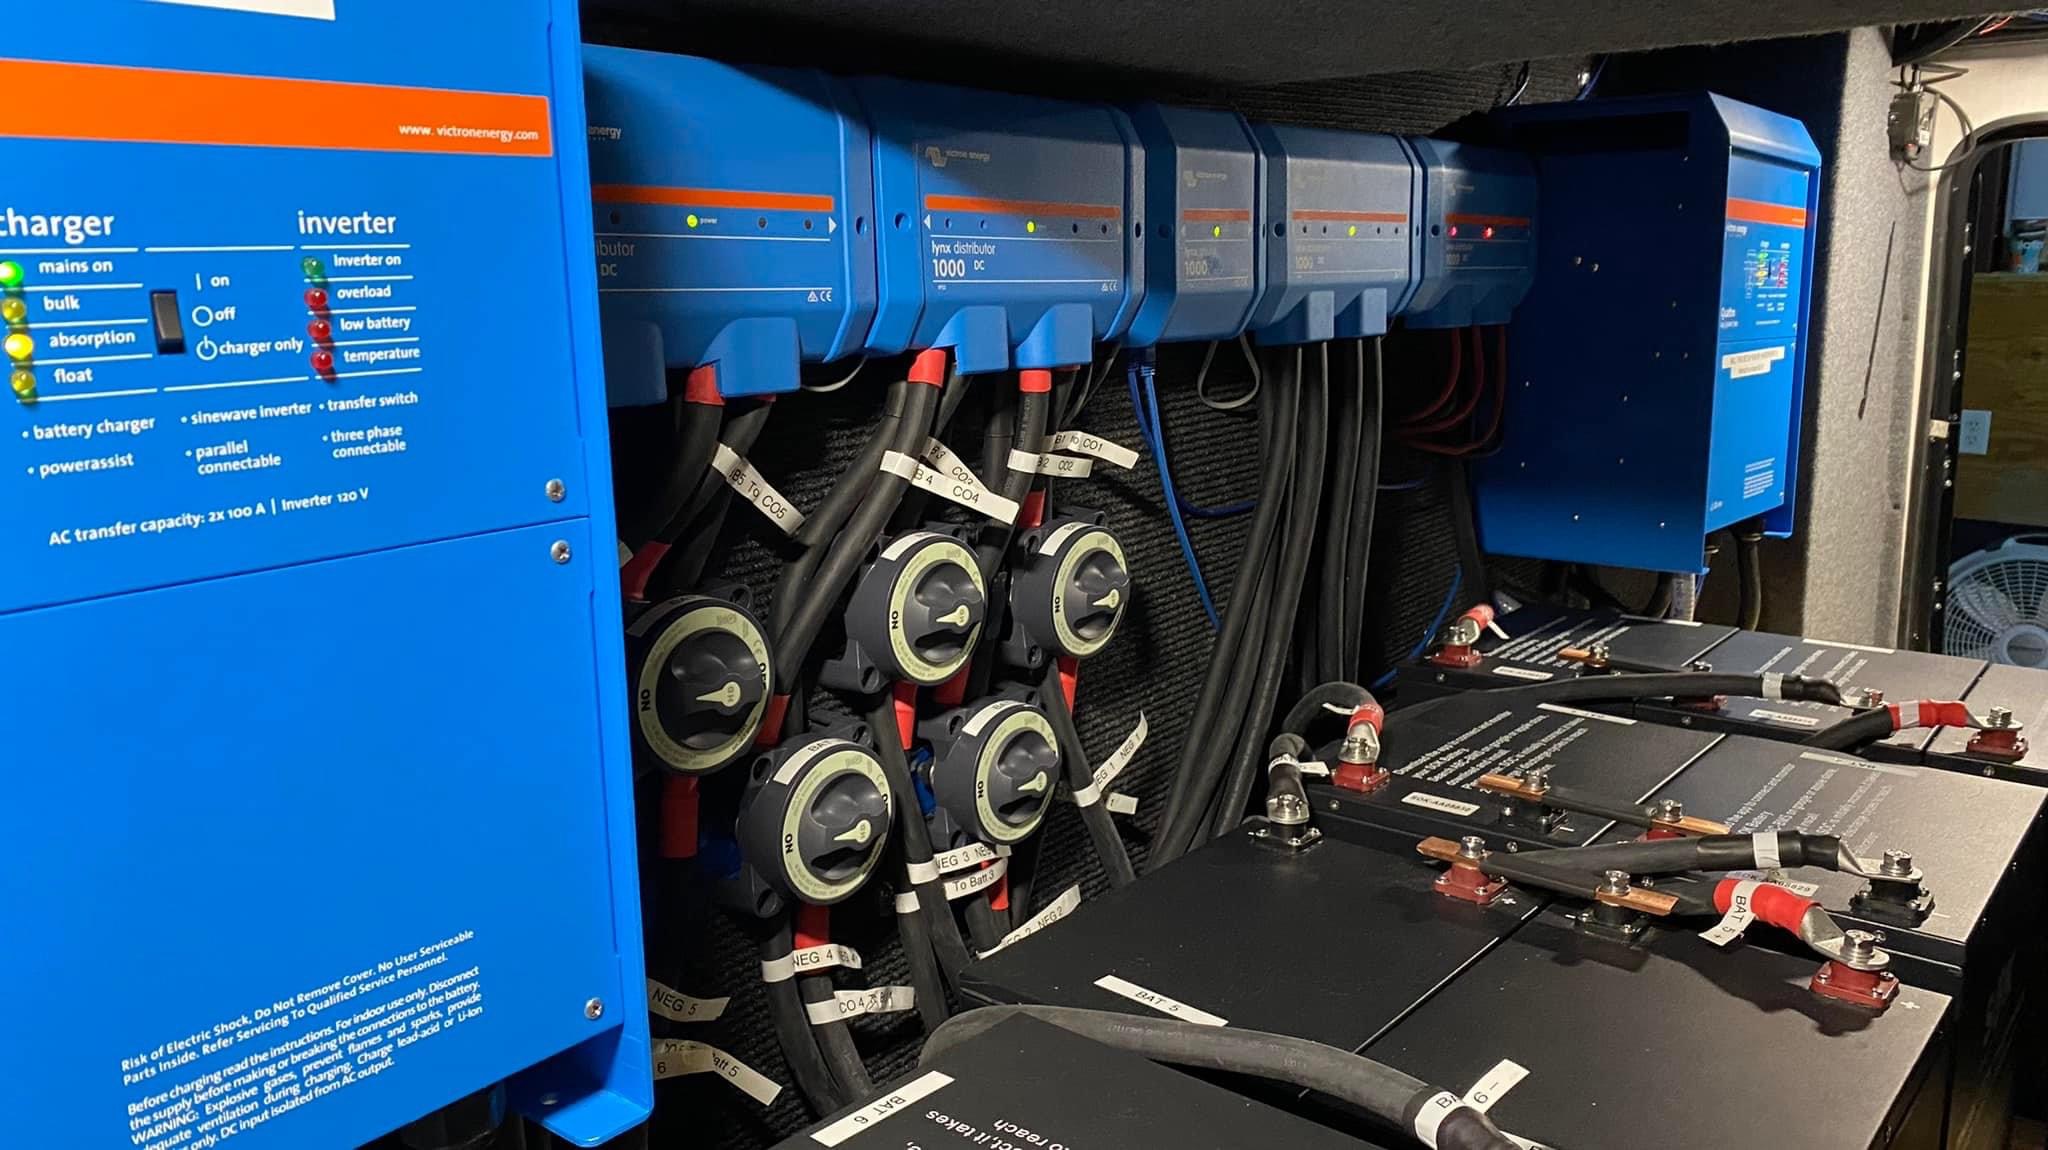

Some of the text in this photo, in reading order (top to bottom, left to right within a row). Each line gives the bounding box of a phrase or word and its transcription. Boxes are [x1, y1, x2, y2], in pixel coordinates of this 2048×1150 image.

[0, 207, 115, 245] charger
[298, 210, 397, 235] inverter
[931, 241, 996, 257] lynx distributor
[38, 260, 114, 273] mains on
[333, 254, 402, 268] Inverter on
[601, 263, 617, 277] DC
[932, 258, 985, 278] 1000 DC
[210, 276, 230, 288] on
[337, 285, 392, 300] overload
[43, 296, 81, 311] bulk
[215, 307, 237, 322] off
[340, 316, 411, 332] low battery
[49, 331, 137, 349] absorption
[218, 337, 304, 357] charger only
[344, 347, 421, 364] temperature
[53, 368, 94, 384] float
[327, 391, 419, 412] transfer switch
[190, 402, 313, 425] sinewave inverter
[33, 415, 156, 441] battery charger
[330, 423, 403, 443] three phase
[195, 440, 249, 461] parallel
[332, 439, 407, 459] connectable
[39, 452, 135, 479] powerassist
[197, 453, 282, 476] connectable
[748, 480, 761, 498] To
[761, 495, 788, 520] CO5
[952, 485, 980, 504] CO4
[49, 487, 370, 546] AC transfer capacity: 2x 100 A Inverter 120 V
[1054, 596, 1061, 614] ON
[891, 610, 899, 630] ON
[640, 689, 651, 712] ON
[1095, 769, 1109, 785] EG
[1119, 739, 1135, 760] NEG
[977, 780, 984, 798] ON
[784, 833, 794, 855] ON
[963, 851, 970, 863] 3
[953, 871, 995, 893] To Batt 3
[1056, 906, 1064, 917] 2
[1722, 895, 1748, 935] BAT 5
[792, 949, 833, 968] NEG 4
[121, 1053, 148, 1072] Risk
[151, 1045, 164, 1061] of
[166, 1030, 211, 1054] Electric
[254, 1008, 271, 1020] Do
[273, 997, 295, 1013] Not
[297, 980, 341, 1003] Remove
[343, 968, 377, 986] Cover.
[377, 961, 394, 973] No
[395, 951, 418, 966] User
[419, 930, 475, 957] Serviceable
[652, 988, 699, 1016] NEG 5
[1135, 990, 1181, 1012] BAT 5
[123, 952, 449, 1086] Parts Inside. Refer Servicing To Qualified Service Personnel.
[128, 1089, 169, 1116] Before
[169, 1069, 223, 1098] charging
[223, 1056, 250, 1077] read
[249, 1049, 270, 1066] the
[335, 1017, 352, 1031] For
[353, 1004, 387, 1024] indoor
[387, 996, 406, 1011] use
[429, 966, 480, 993] Disconnect
[129, 1115, 151, 1131] the
[152, 1098, 193, 1123] supply
[194, 1080, 233, 1104] before
[233, 1063, 277, 1088] making
[277, 1057, 289, 1070] or
[290, 1039, 338, 1065] breaking
[339, 1030, 357, 1045] the
[357, 1006, 416, 1037] connections
[416, 999, 428, 1012] to
[428, 994, 444, 1008] the
[131, 1110, 200, 1145] WARNING:
[205, 1086, 258, 1115] Explosive
[302, 1049, 344, 1076] prevent
[348, 1033, 383, 1054] flames
[387, 1022, 406, 1038] and
[447, 992, 482, 1017] provide
[657, 1061, 740, 1078] 6 5
[197, 1101, 259, 1133] ventilation
[263, 1082, 301, 1105] during
[357, 1042, 394, 1066] Charge
[397, 1022, 440, 1048] lead-acid
[443, 1016, 454, 1028] or
[220, 1123, 238, 1140] DC
[239, 1108, 270, 1130] input
[270, 1089, 314, 1117] isolated
[314, 1080, 341, 1098] from
[341, 1071, 358, 1087] AC
[1473, 1091, 1489, 1104] 6
[853, 1095, 907, 1125] BAT 6
[925, 1110, 976, 1138] takes
[993, 1118, 1049, 1147] reach
